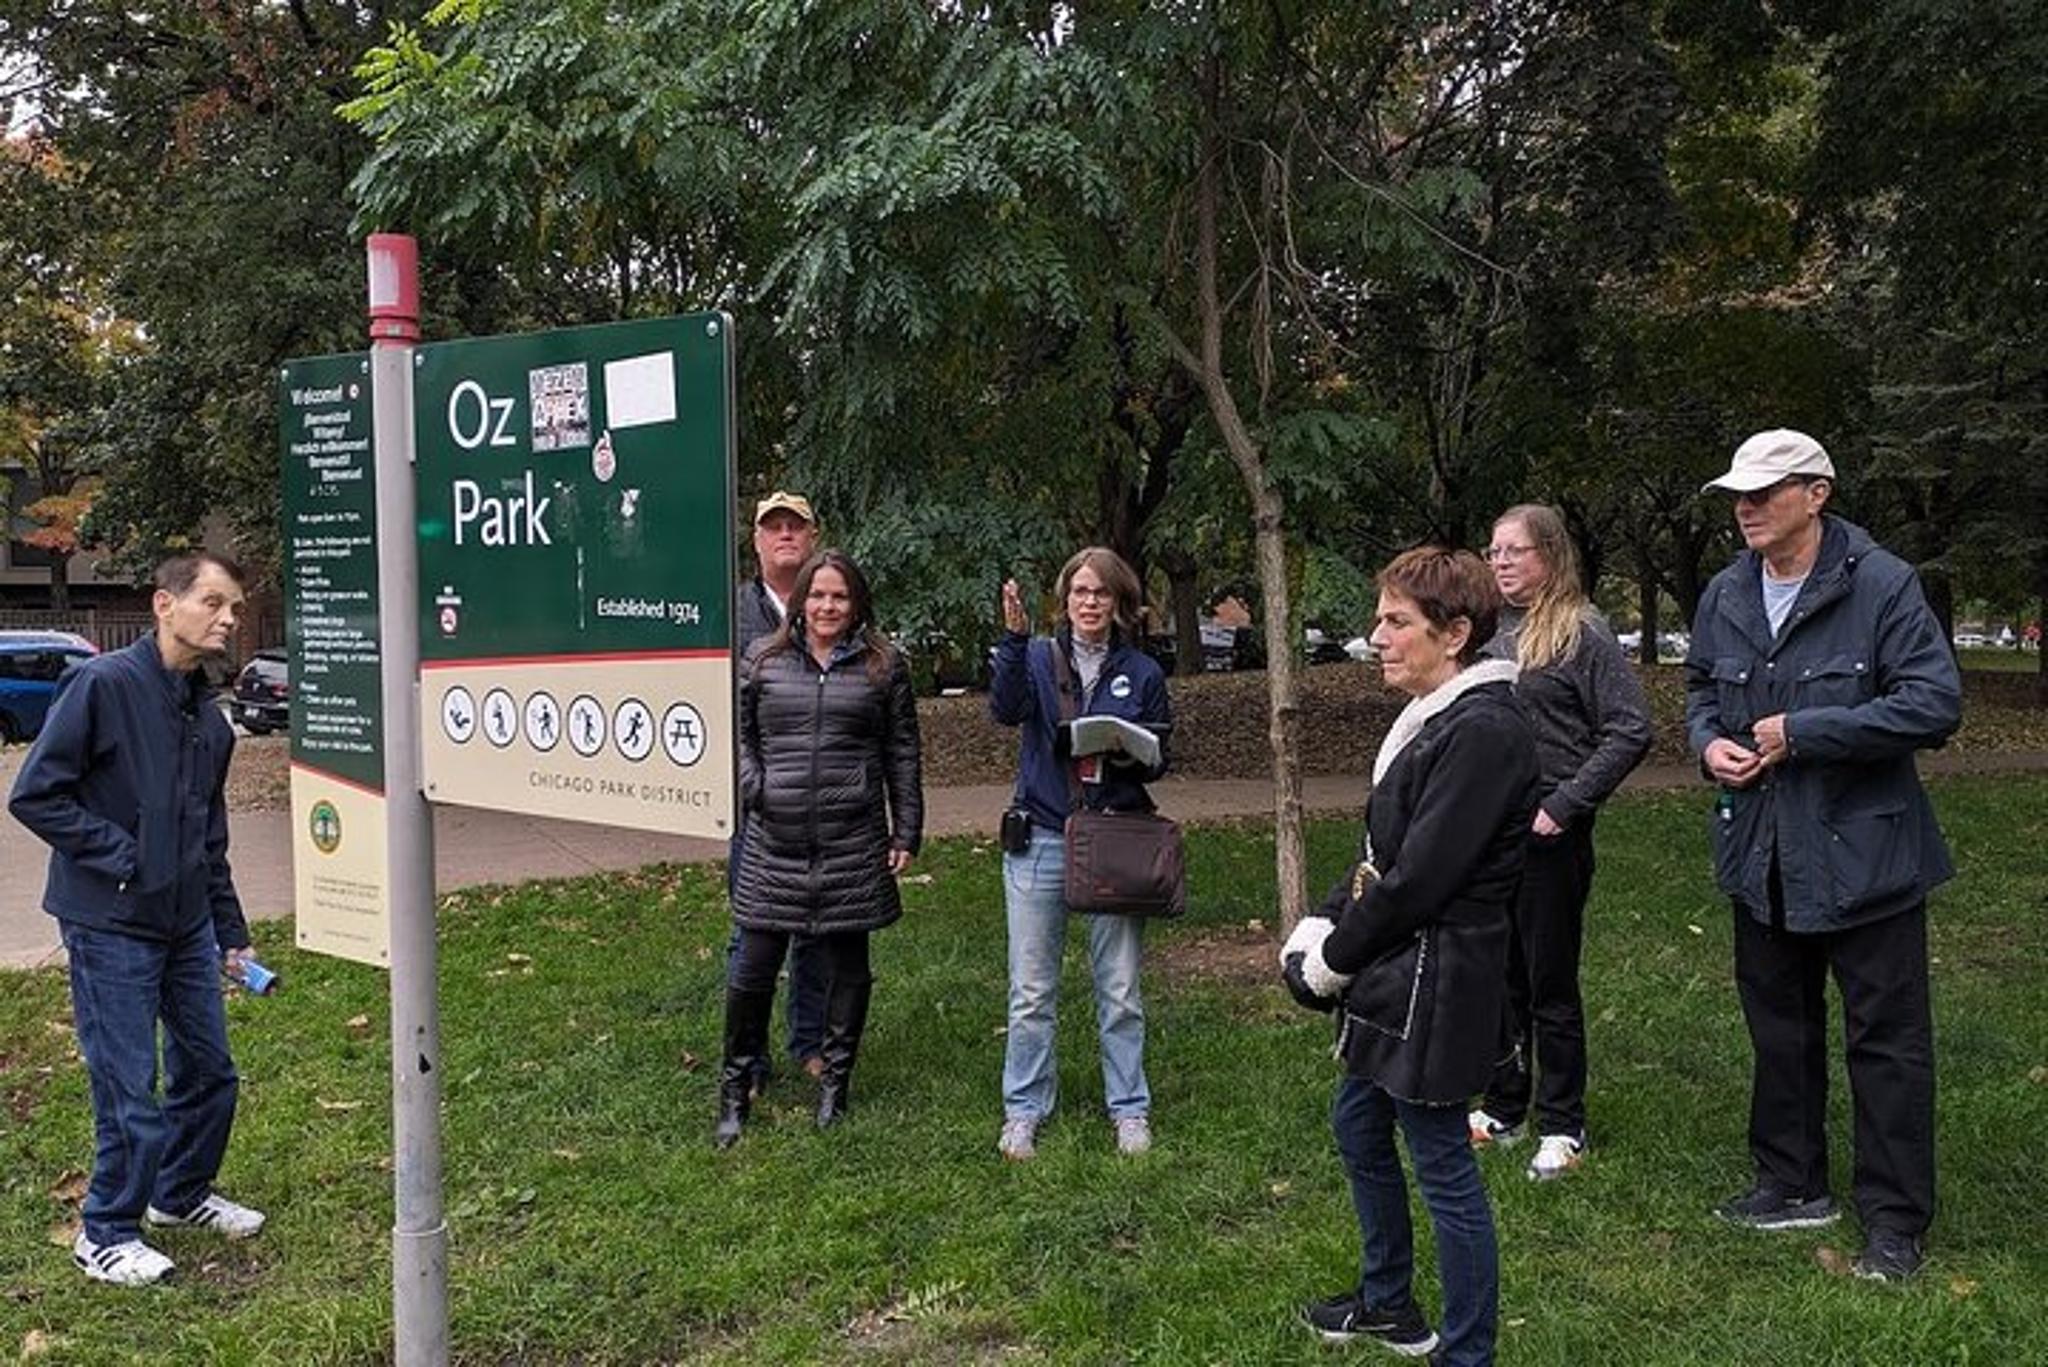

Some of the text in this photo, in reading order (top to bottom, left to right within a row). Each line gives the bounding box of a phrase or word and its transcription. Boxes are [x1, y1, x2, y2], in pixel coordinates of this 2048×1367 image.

[449, 380, 517, 450] Oz
[453, 469, 552, 546] Park
[598, 598, 700, 624] Established 1974
[529, 771, 712, 807] CHICAGO PARK DISTRICT
